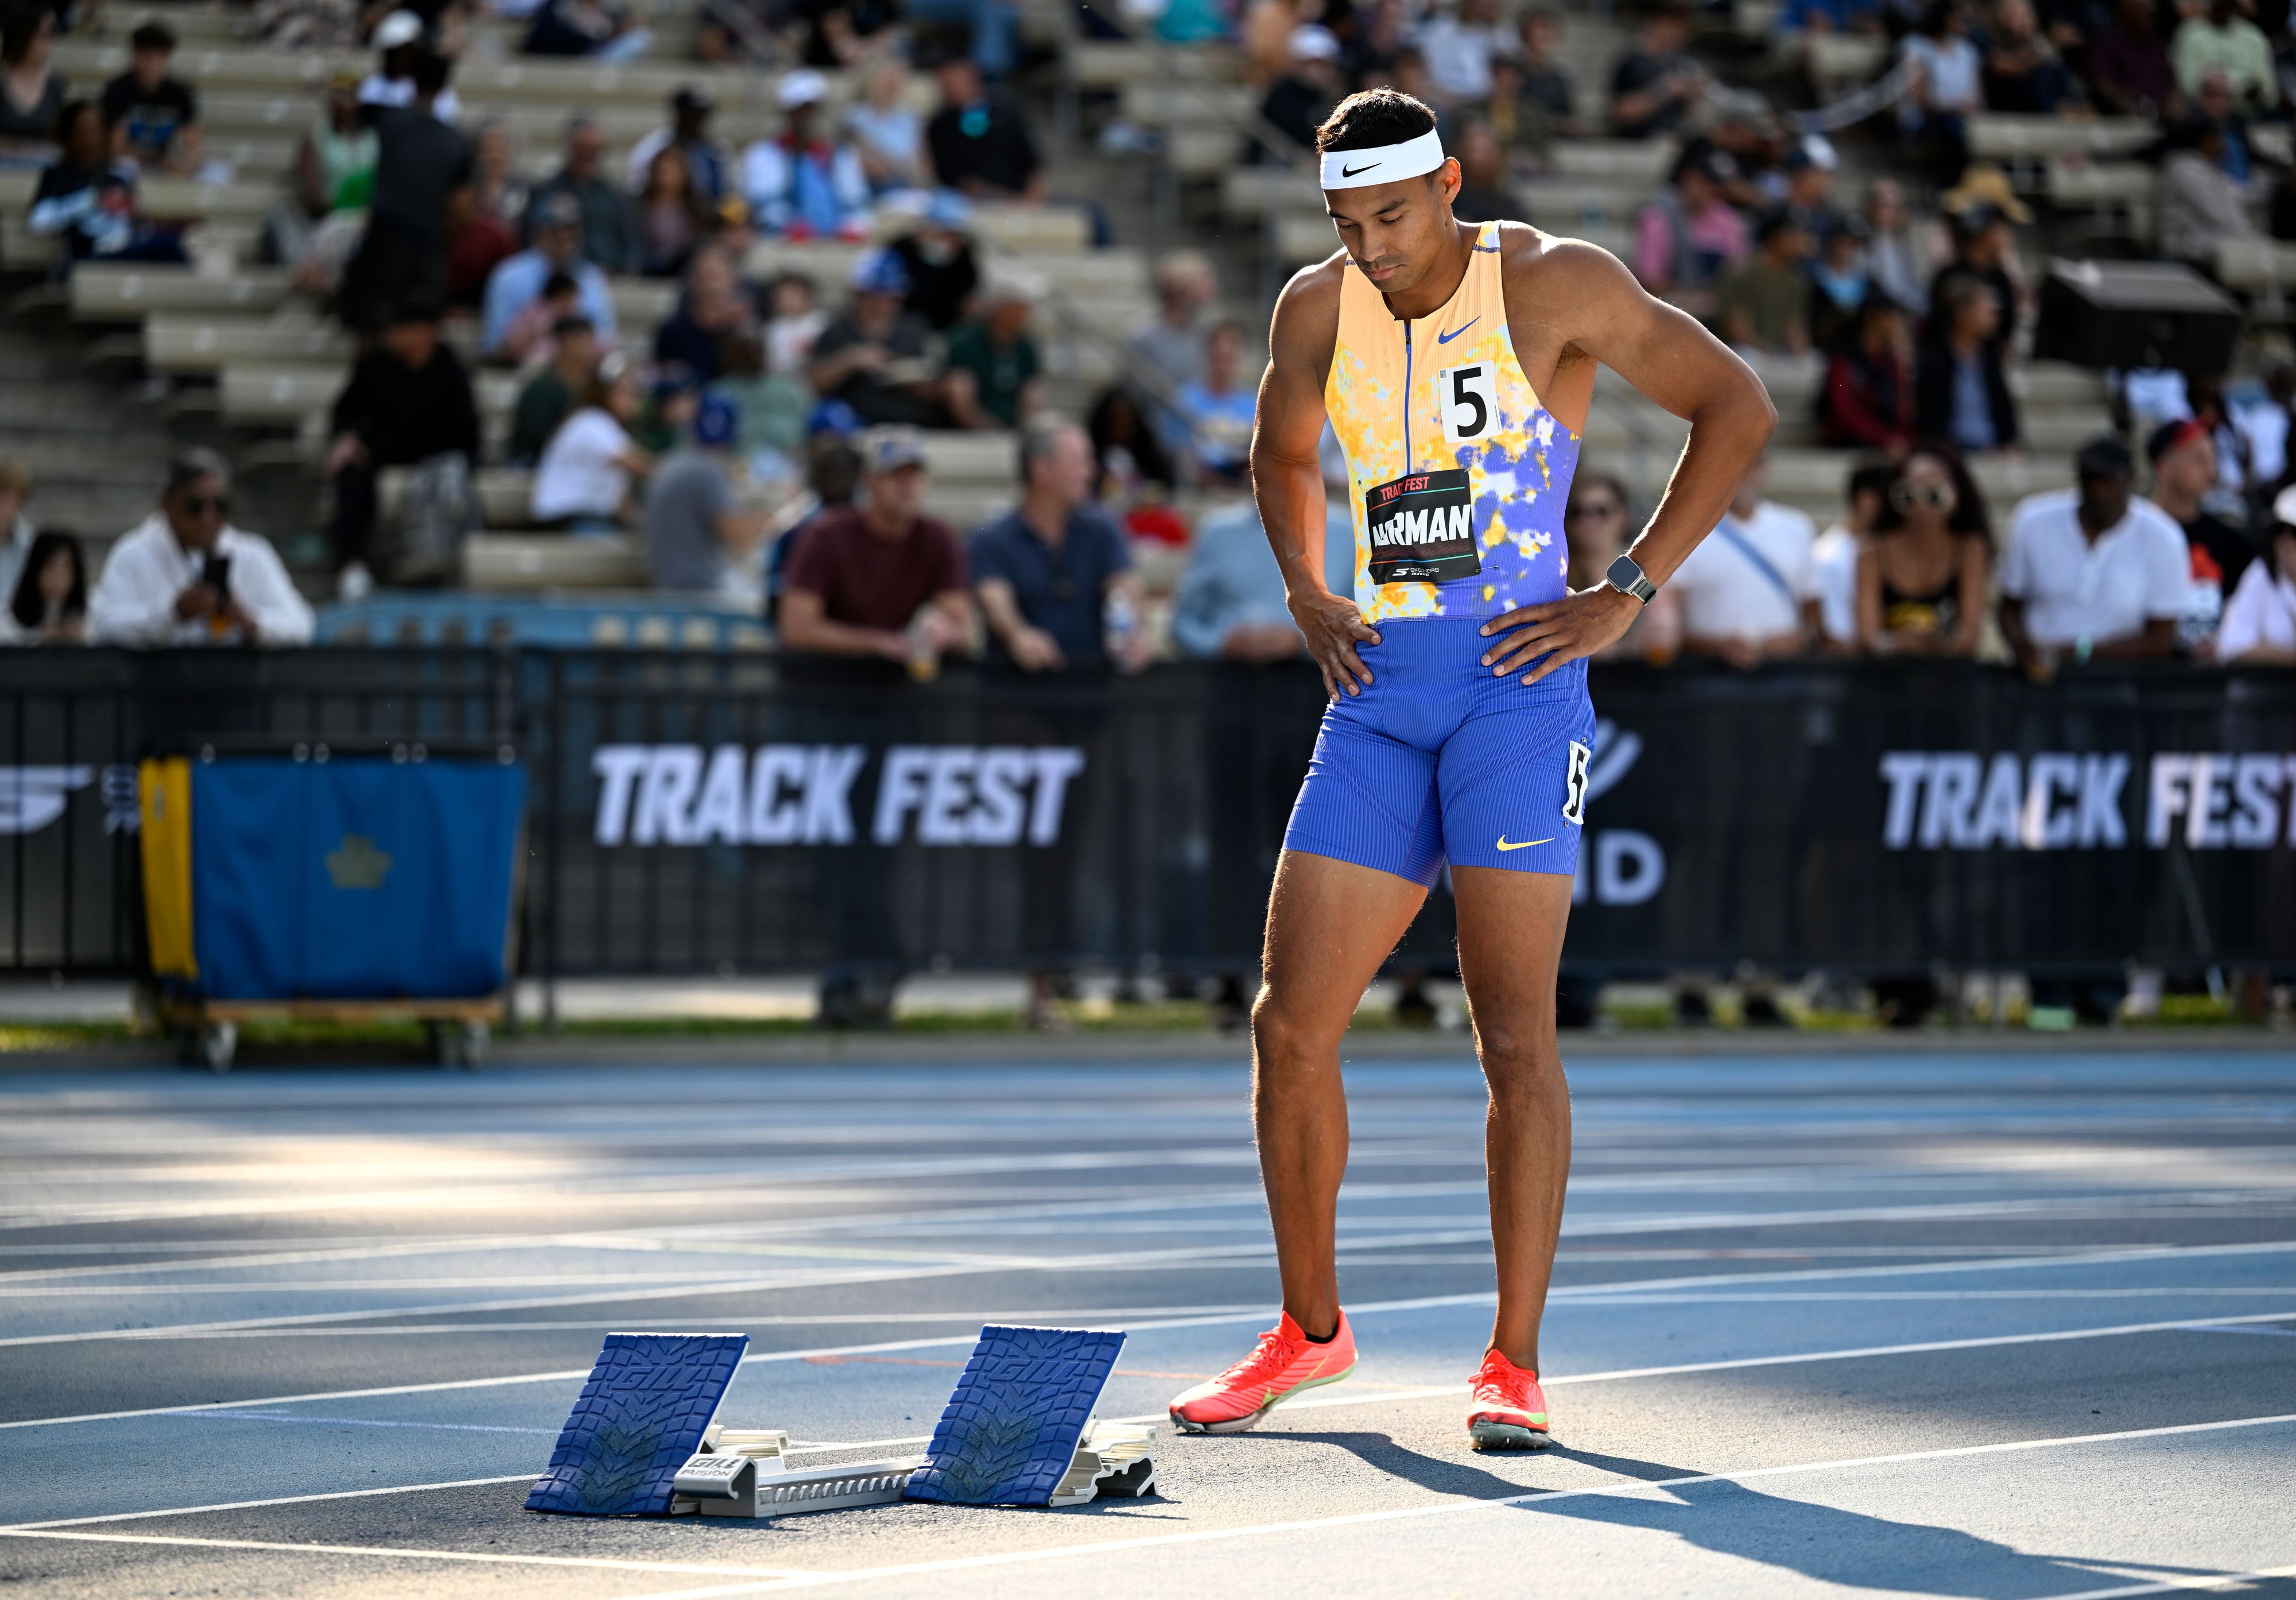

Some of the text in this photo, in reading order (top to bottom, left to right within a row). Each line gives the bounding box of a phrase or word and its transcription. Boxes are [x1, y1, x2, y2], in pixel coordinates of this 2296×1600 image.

[1453, 366, 1487, 437] 5
[1380, 476, 1430, 501] TRAC FEST
[593, 744, 1085, 846] TRACK FEST
[1880, 752, 2296, 851] TRACK FES
[990, 1359, 1080, 1385] GILL
